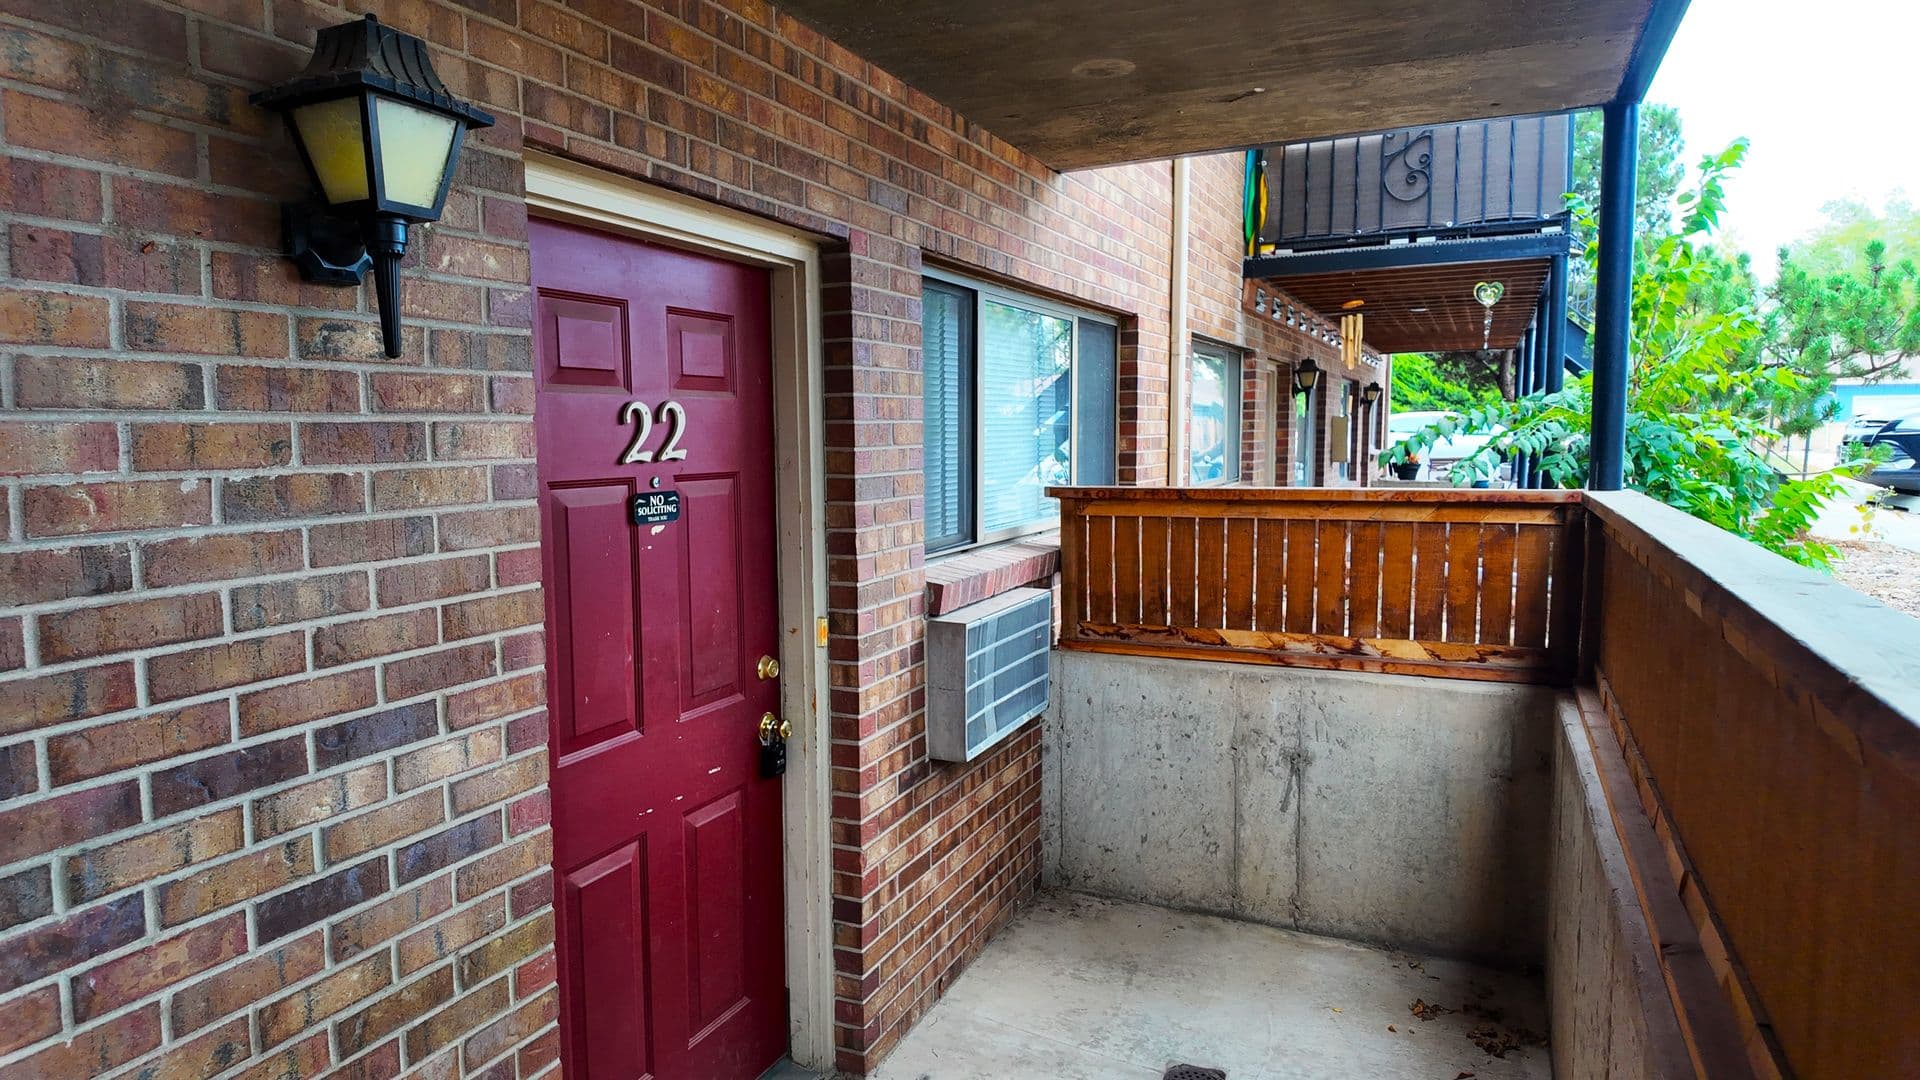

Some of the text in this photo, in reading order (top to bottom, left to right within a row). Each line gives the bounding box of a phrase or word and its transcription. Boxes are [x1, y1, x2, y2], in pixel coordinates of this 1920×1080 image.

[622, 401, 687, 464] 22
[650, 495, 664, 506] NO
[638, 504, 677, 516] SOLICITING
